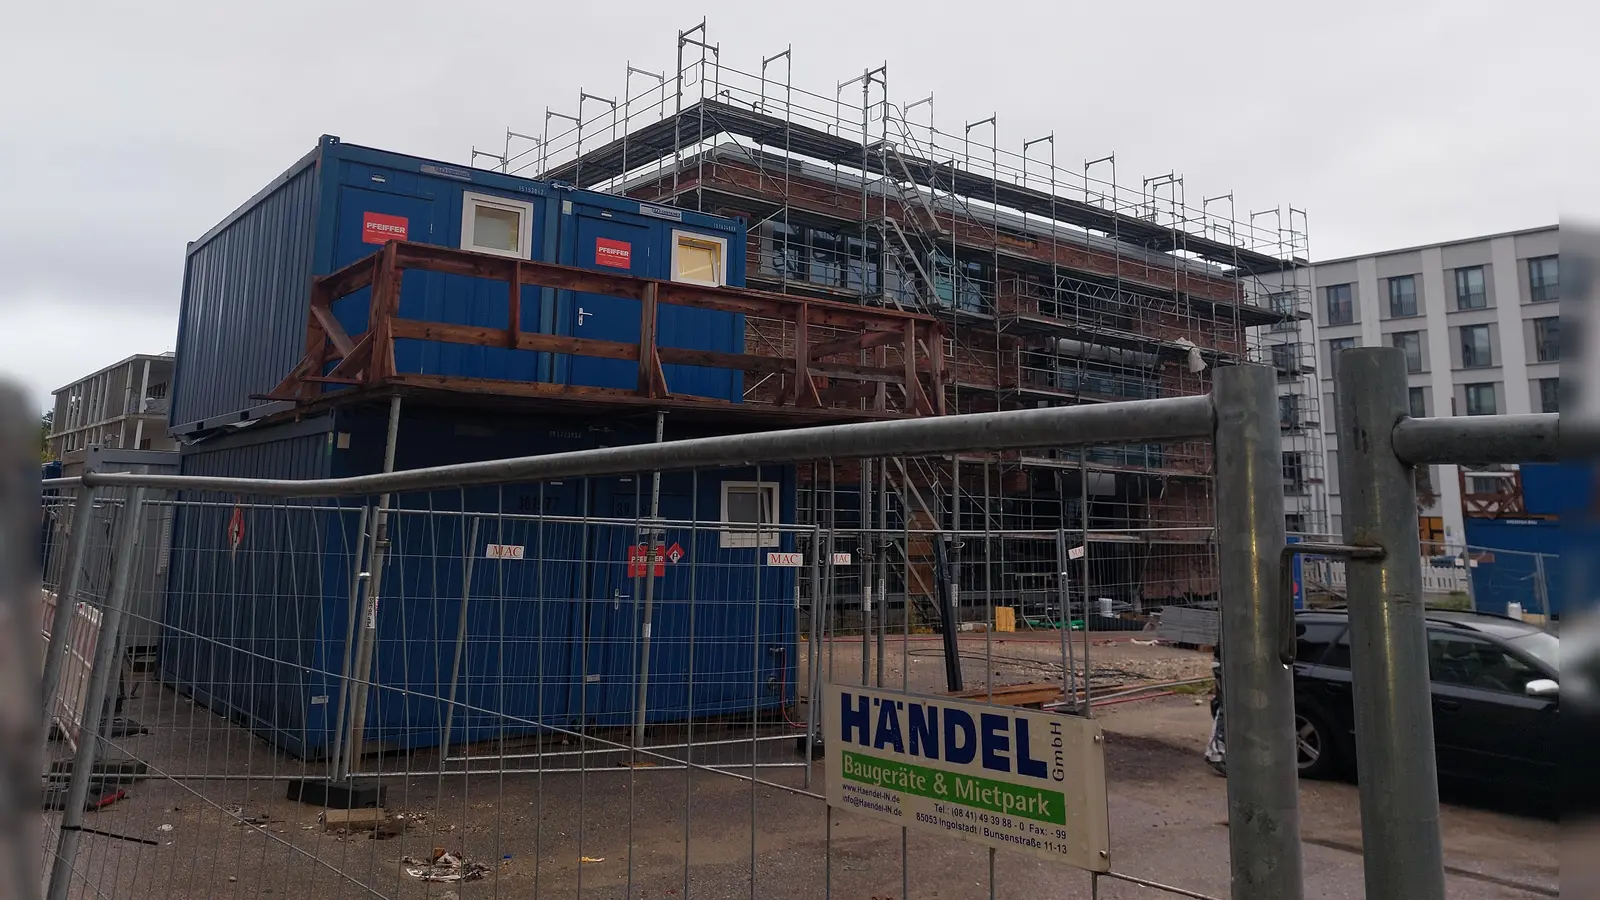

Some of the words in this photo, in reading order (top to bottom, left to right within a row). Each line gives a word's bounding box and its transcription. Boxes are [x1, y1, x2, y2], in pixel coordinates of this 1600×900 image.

[366, 221, 406, 234] PFEIFFER
[598, 246, 629, 257] PFEIFFER
[493, 545, 521, 557] MAC
[771, 553, 799, 564] MAC
[841, 692, 1048, 779] HÄNDEL
[1050, 722, 1064, 782] GmbH
[842, 783, 900, 804] www.Haendel-IN.de
[844, 755, 926, 791] Baugeräte
[933, 773, 948, 795] &
[955, 777, 1051, 817] Mietpark
[843, 795, 902, 816] info@Haendel-IN.de
[916, 812, 938, 825] 85053
[939, 817, 978, 835] Ingolstadt
[983, 827, 1041, 849] Bunsenstraße
[1044, 840, 1067, 854] 11-13
[951, 807, 964, 818] (08
[965, 810, 977, 823] 41)
[979, 813, 988, 823] 49
[990, 815, 1000, 825] 39
[1002, 818, 1012, 828] 88
[1019, 821, 1025, 831] 0
[1029, 823, 1048, 836] Fax:
[1055, 829, 1067, 840] 99
